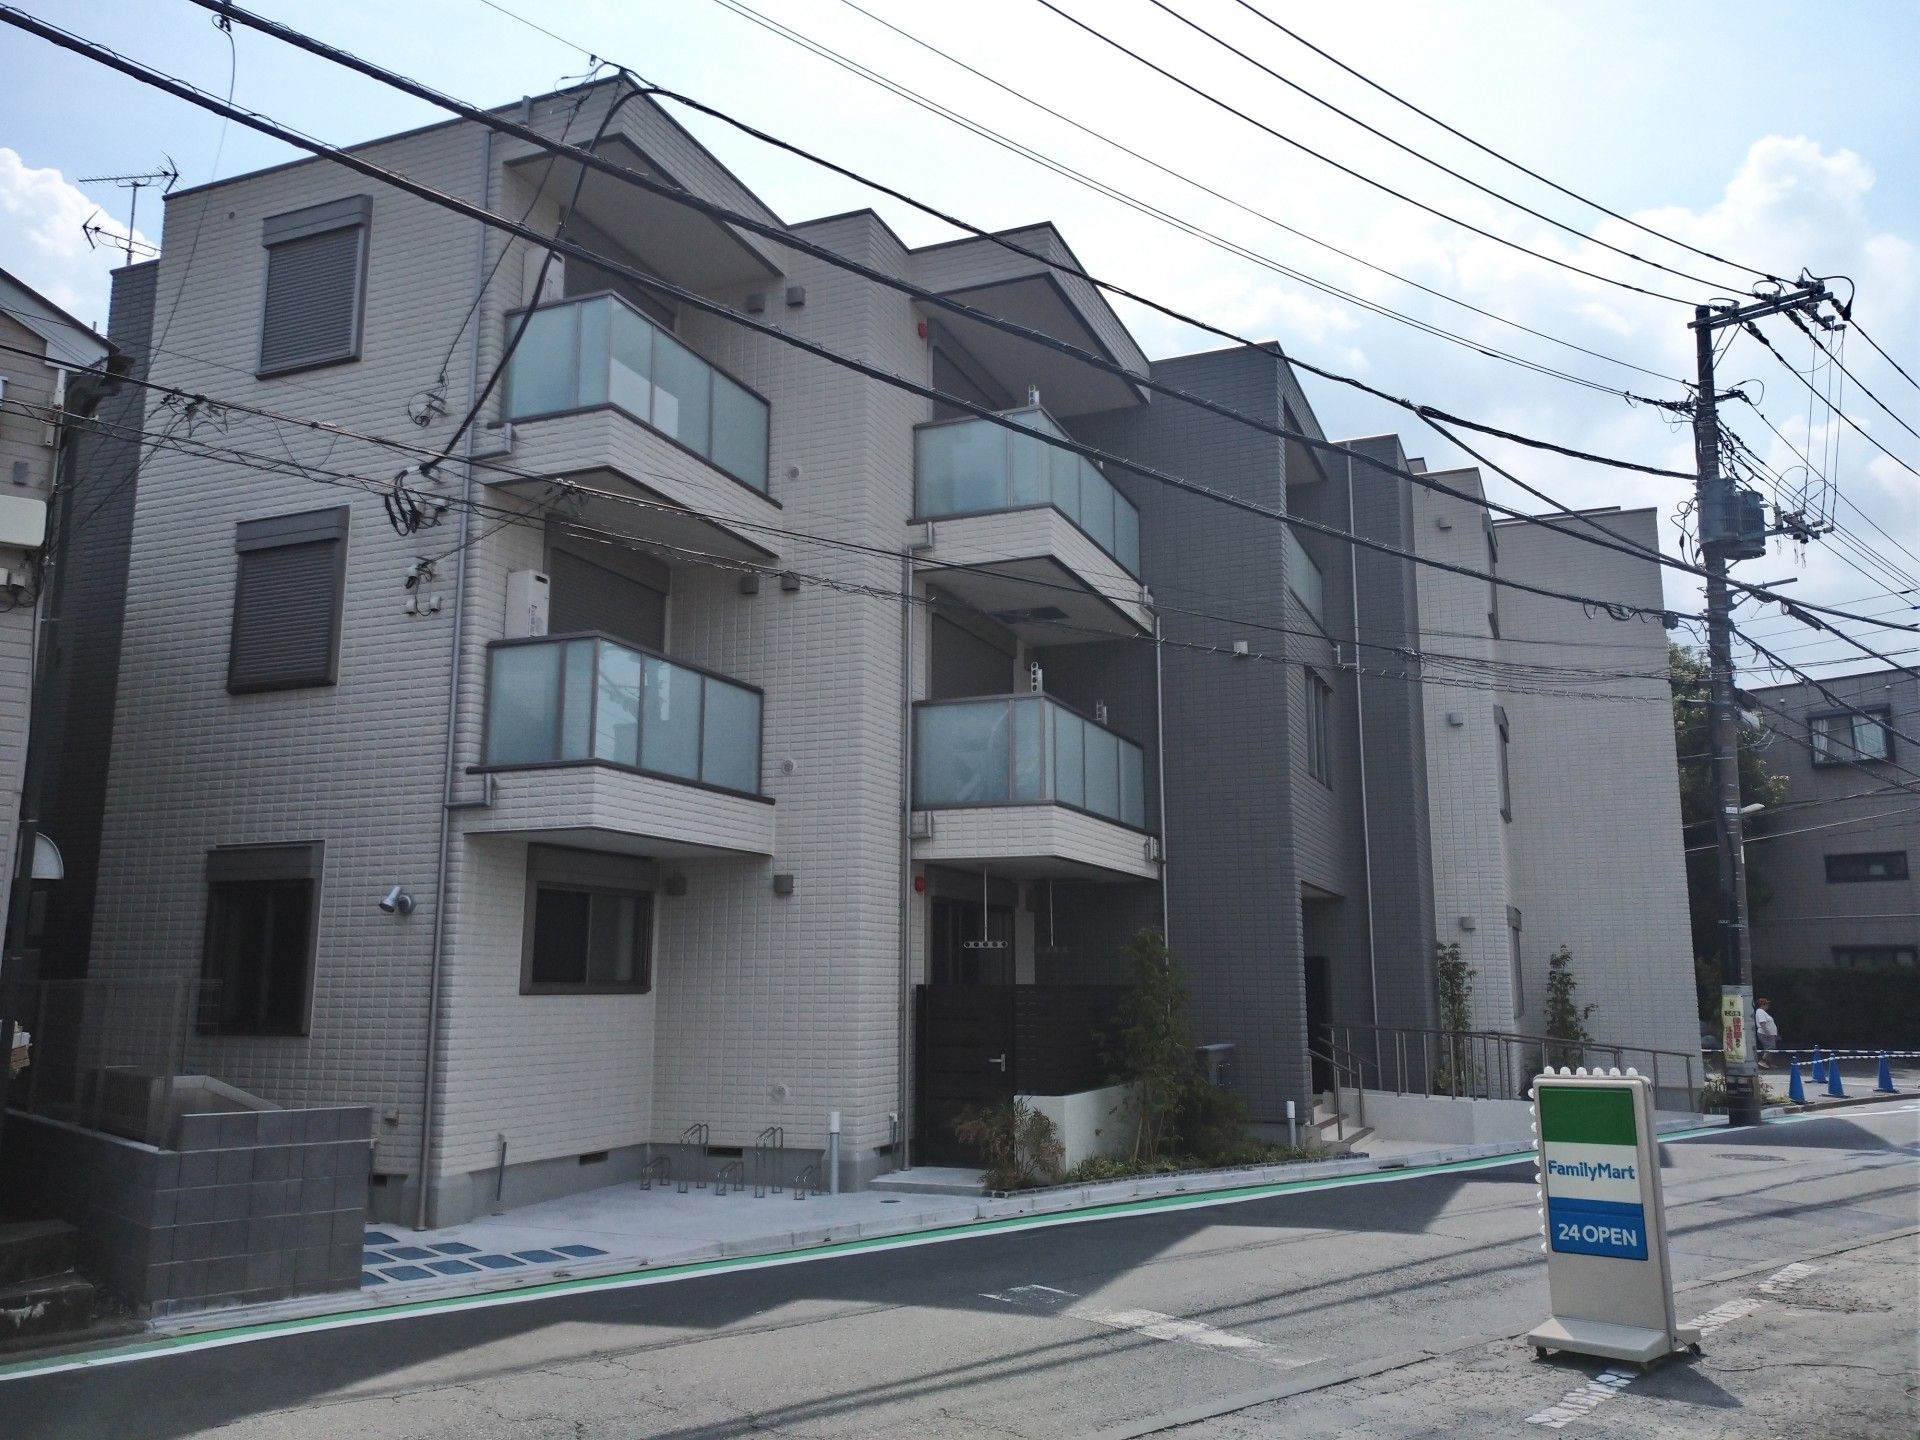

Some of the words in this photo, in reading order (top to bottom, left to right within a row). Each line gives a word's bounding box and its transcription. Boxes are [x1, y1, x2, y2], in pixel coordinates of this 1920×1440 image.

[1547, 1160, 1636, 1181] FamilyMart
[1558, 1223, 1581, 1241] 24
[1582, 1225, 1638, 1247] OPEN
